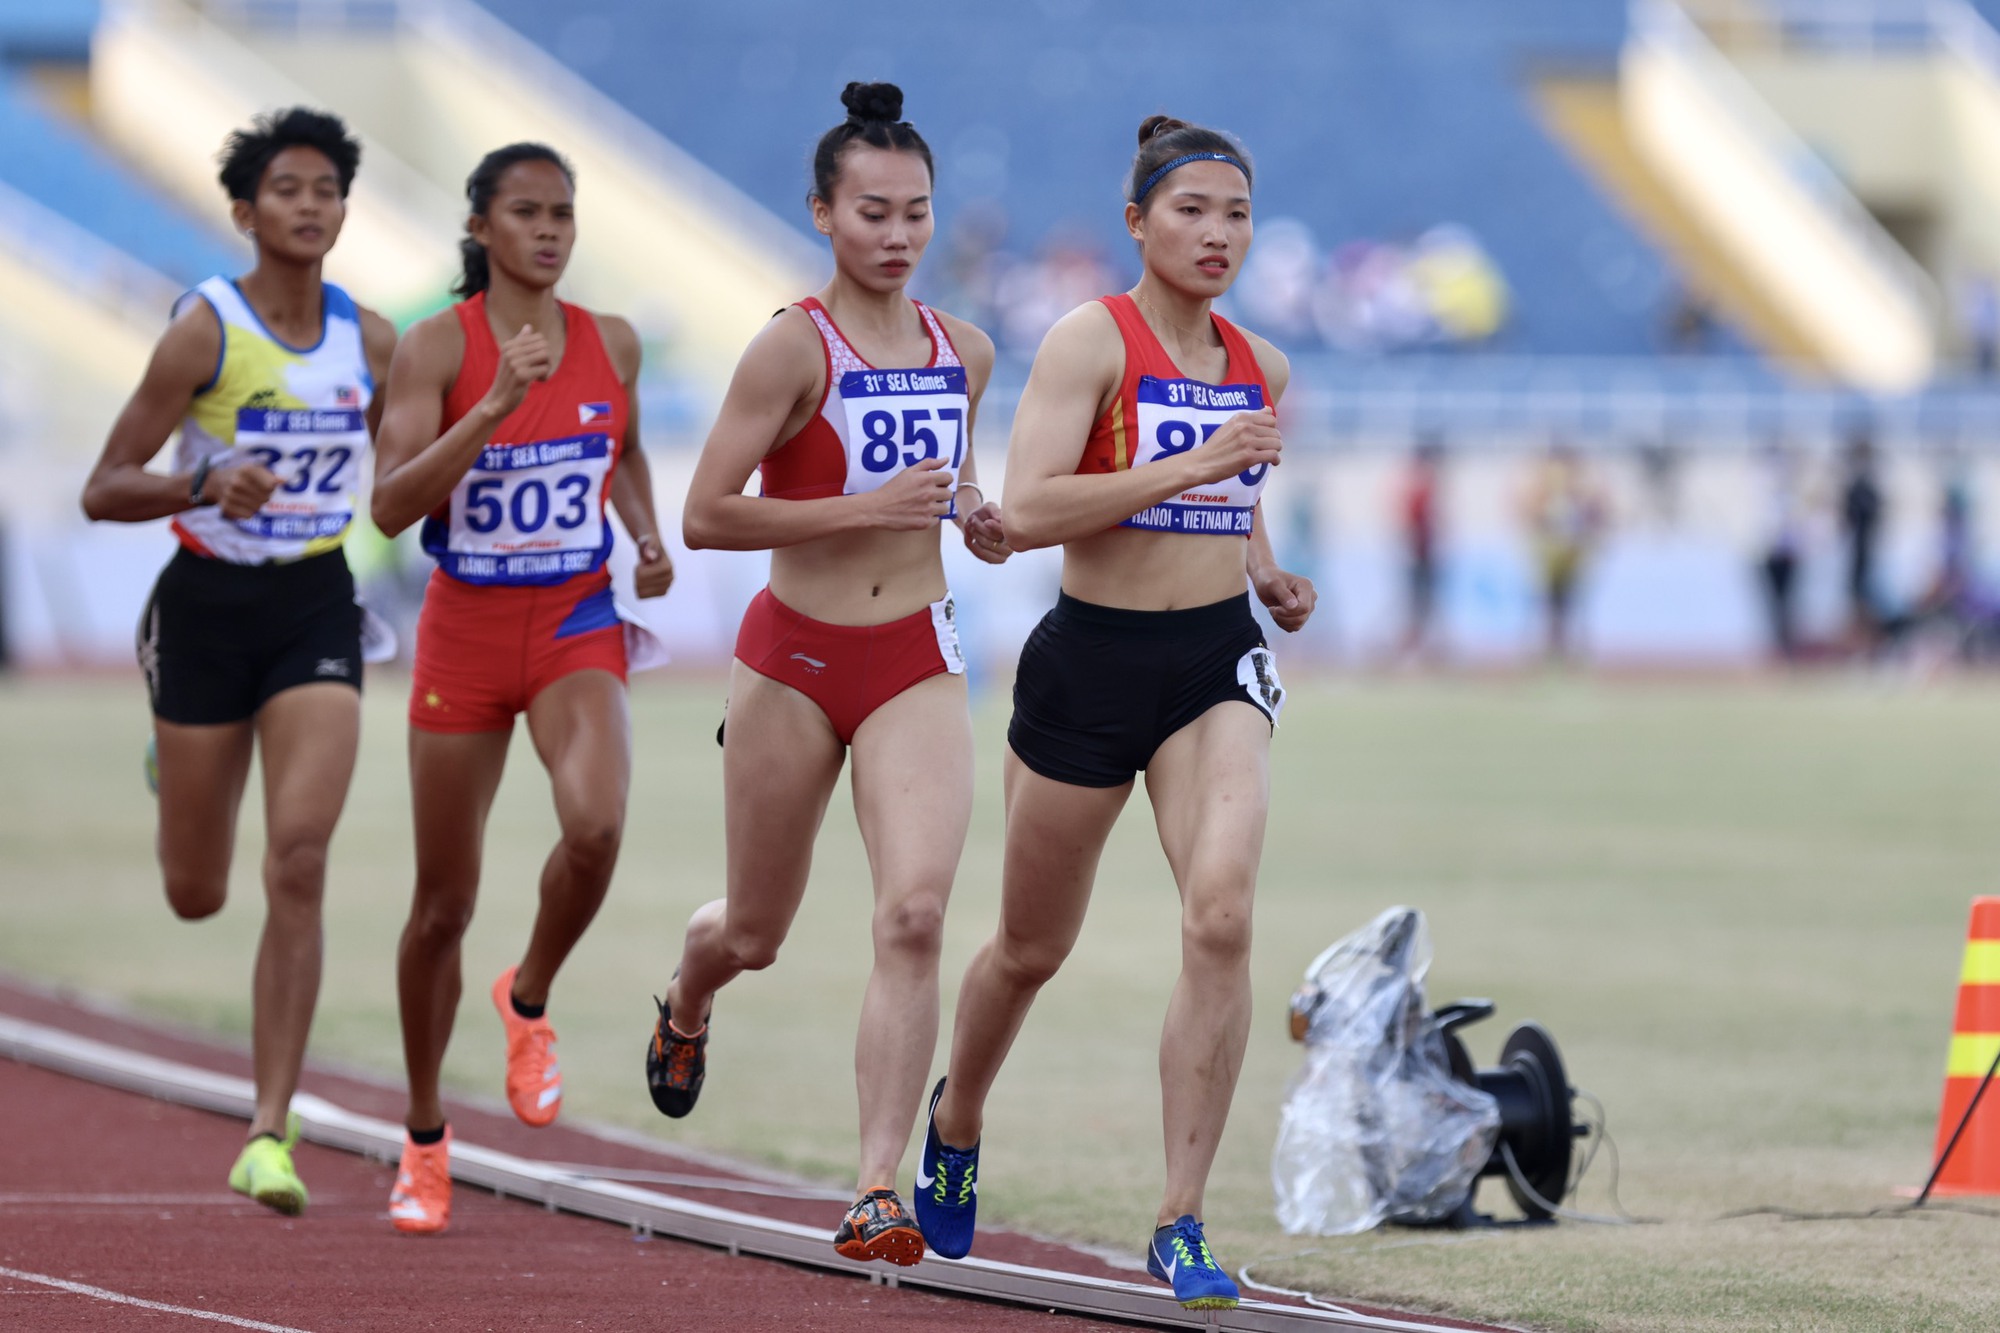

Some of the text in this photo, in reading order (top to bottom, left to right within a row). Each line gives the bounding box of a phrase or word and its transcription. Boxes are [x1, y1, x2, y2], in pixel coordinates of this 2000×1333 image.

[886, 373, 910, 392] SEA
[910, 372, 948, 391] Games
[1192, 385, 1208, 406] SEA
[1208, 389, 1249, 407] Games
[861, 408, 963, 473] 857
[511, 444, 539, 468] SEA
[539, 441, 584, 464] Games
[464, 472, 592, 534] 503
[1181, 493, 1229, 503] VIETNAM
[1183, 509, 1233, 531] VIETNAM
[1234, 510, 1251, 531] 202
[457, 555, 498, 577] HANOI
[507, 552, 561, 576] VIETNAM
[562, 550, 594, 572] 2022
